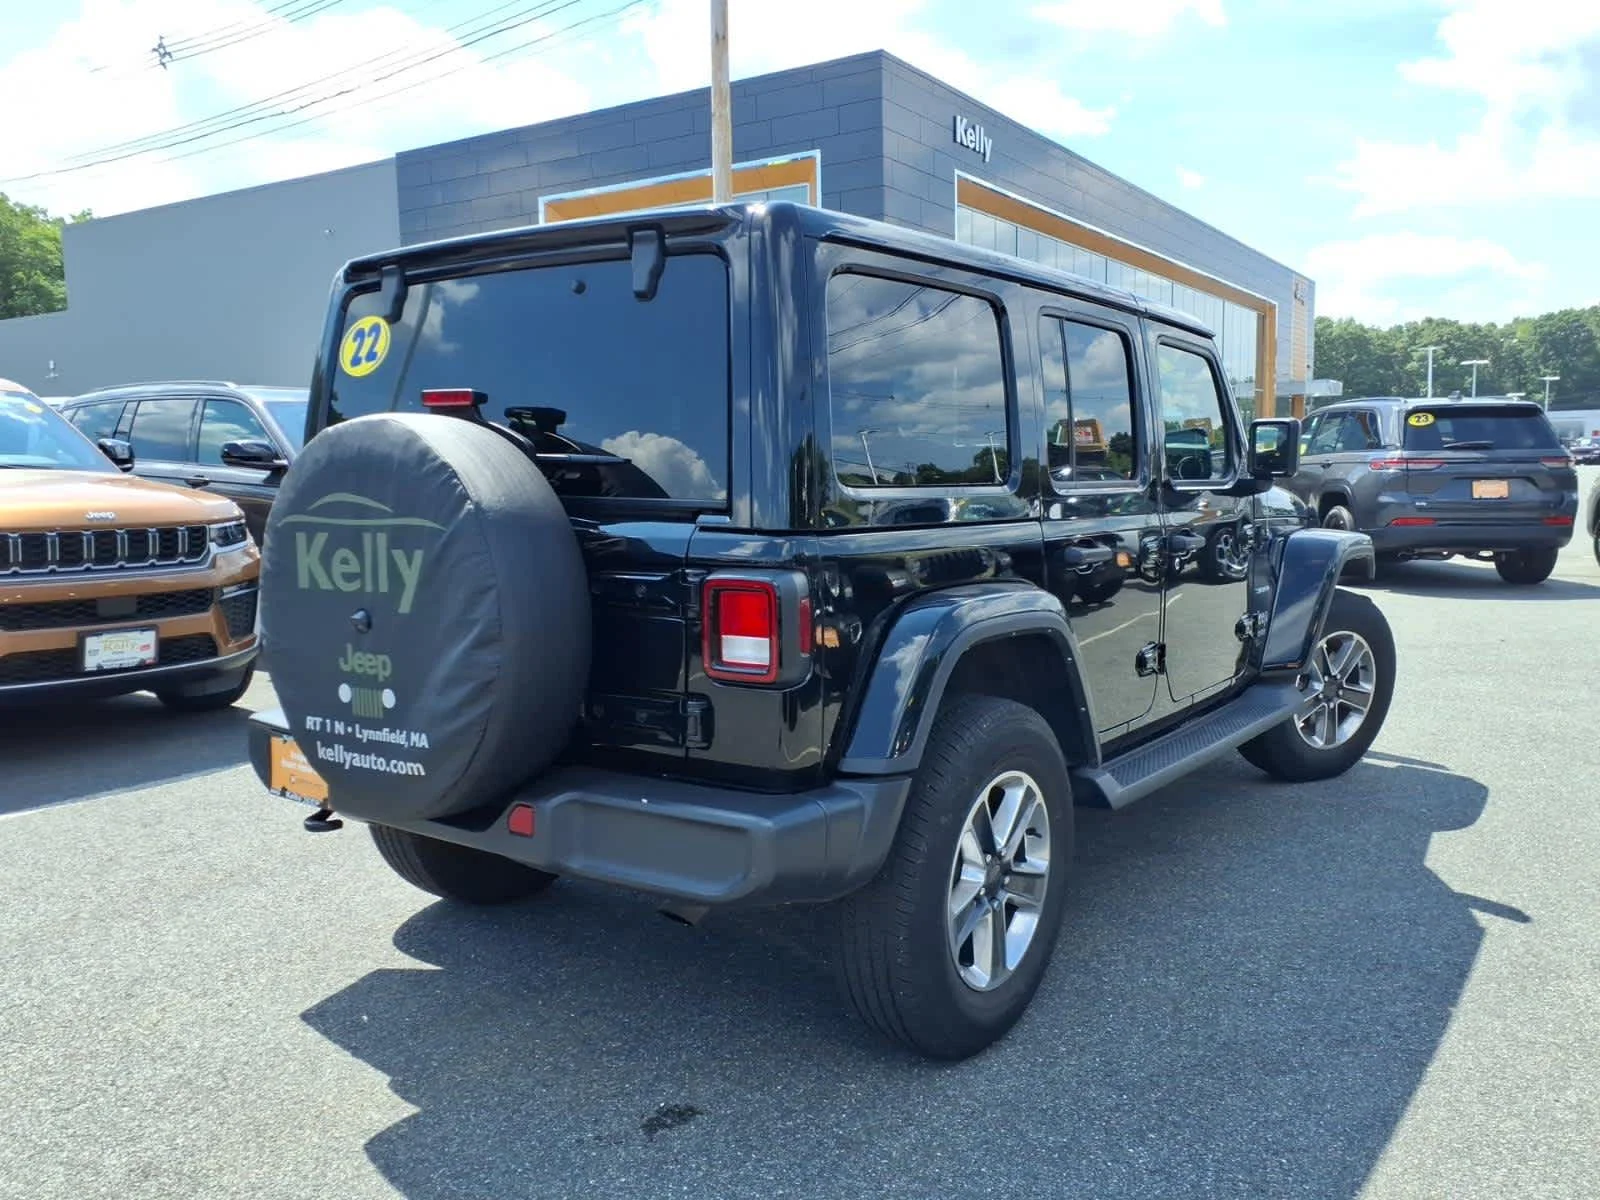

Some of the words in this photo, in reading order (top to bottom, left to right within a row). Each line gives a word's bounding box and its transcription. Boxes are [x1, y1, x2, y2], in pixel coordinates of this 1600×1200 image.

[953, 114, 993, 163] Kelly
[350, 322, 382, 368] 22
[85, 511, 116, 521] Jeep
[295, 532, 425, 614] Kelly
[338, 643, 393, 682] Jeep
[305, 715, 323, 732] RT
[325, 719, 331, 733] 1
[334, 720, 345, 736] N
[354, 723, 409, 748] Lynnfield,
[316, 740, 426, 777] kellyauto.com
